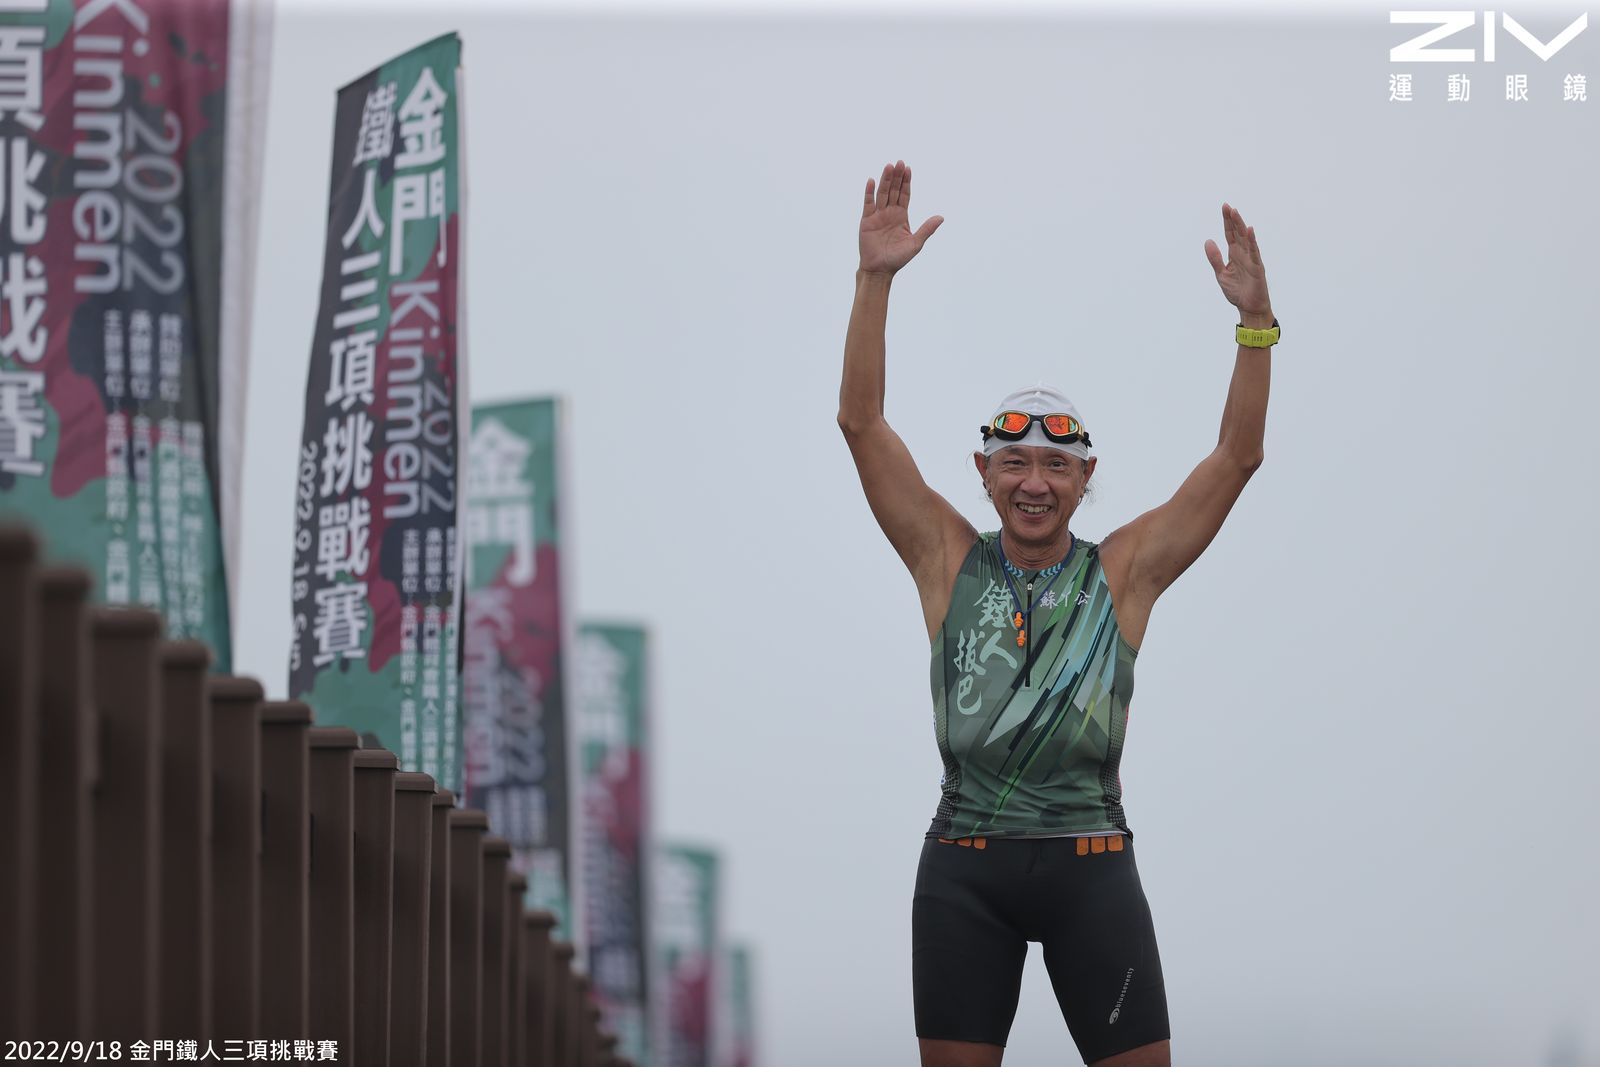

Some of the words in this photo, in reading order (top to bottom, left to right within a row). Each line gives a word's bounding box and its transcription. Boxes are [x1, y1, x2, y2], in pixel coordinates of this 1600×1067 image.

[72, 0, 149, 293] Kinmen
[122, 107, 185, 294] 2022
[389, 66, 448, 277] 金門
[383, 280, 440, 519] Kinmen
